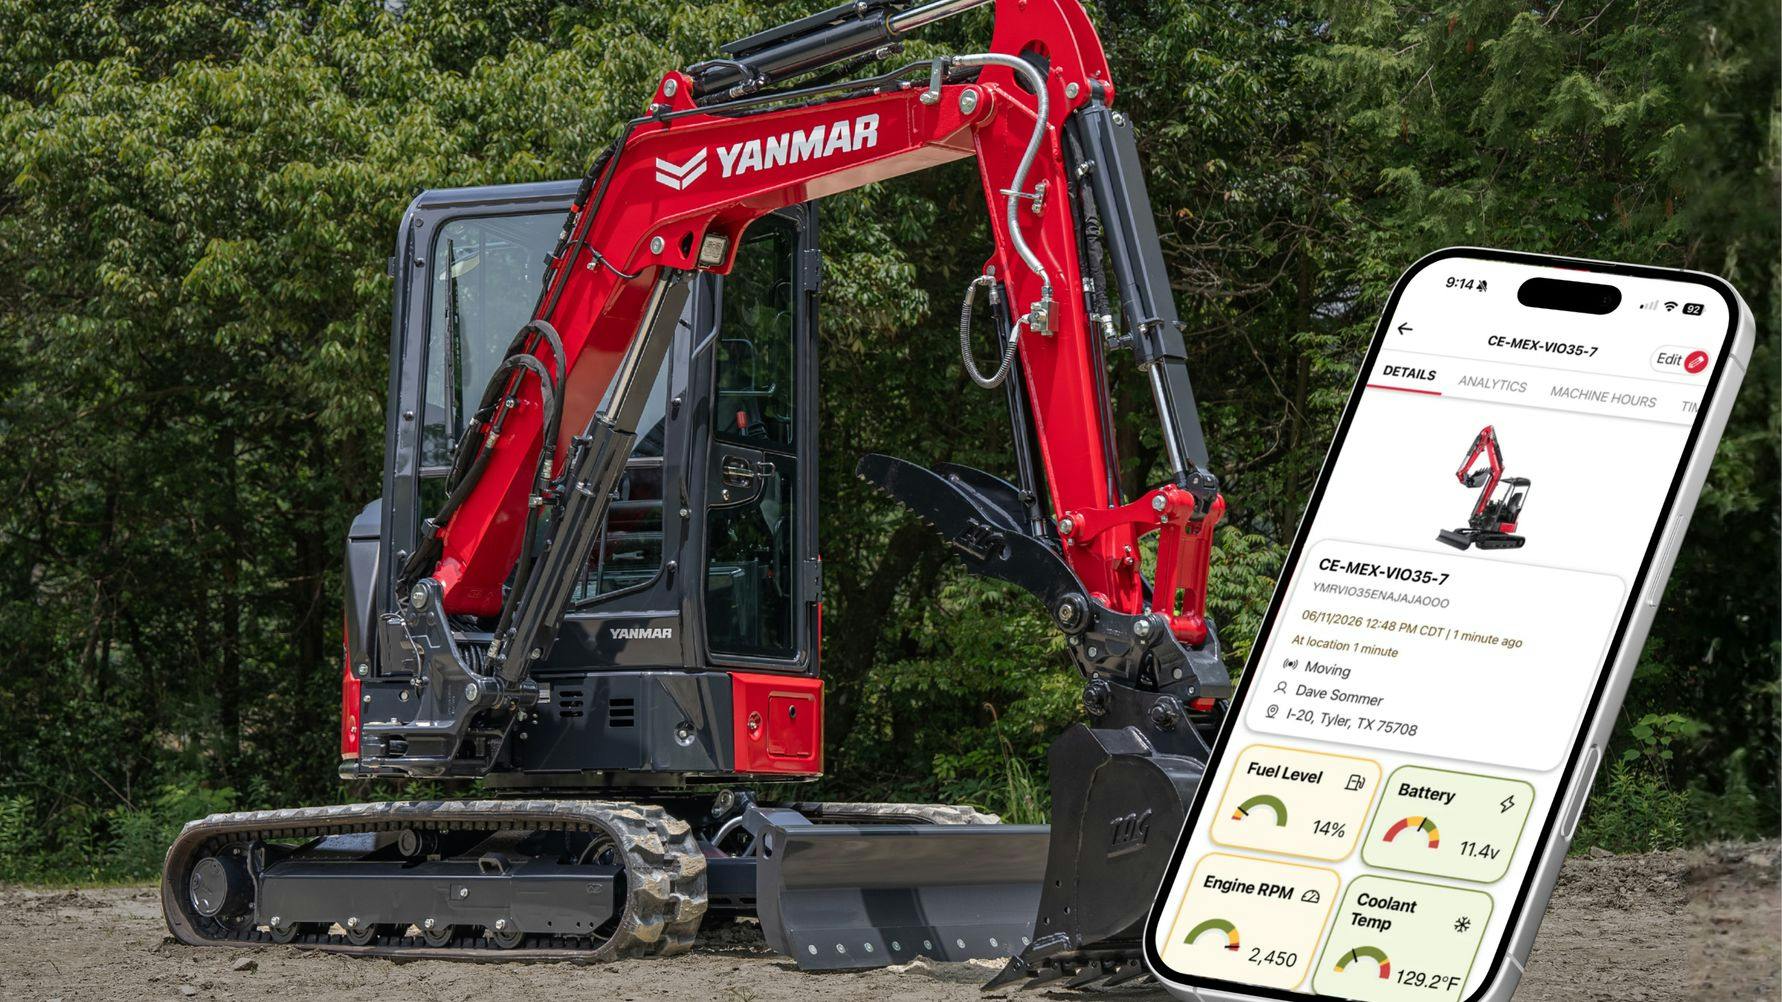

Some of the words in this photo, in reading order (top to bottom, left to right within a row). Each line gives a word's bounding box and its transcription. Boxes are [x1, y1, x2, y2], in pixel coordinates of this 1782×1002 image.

[716, 113, 880, 178] YANMAR
[1446, 277, 1474, 290] 9:14
[1687, 305, 1700, 313] 92
[1657, 353, 1682, 366] Edit
[1383, 365, 1436, 381] DETAILS
[1458, 376, 1527, 392] ANALYTICS
[1551, 386, 1609, 402] MACHINE
[1611, 393, 1657, 408] HOURS
[610, 628, 673, 639] YANMAR
[1302, 610, 1363, 627] 06/11/2026
[1367, 618, 1396, 631] 12:48
[1399, 623, 1417, 633] PM
[1420, 626, 1445, 637] CDT
[1454, 630, 1459, 639] 1
[1461, 632, 1499, 644] minute
[1501, 639, 1522, 649] ago
[1292, 635, 1304, 645] At
[1307, 636, 1350, 651] location
[1354, 643, 1359, 652] 1
[1361, 646, 1398, 657] minute
[1305, 661, 1351, 679] Moving
[1296, 684, 1327, 699] Dave
[1330, 689, 1384, 706] Sommer
[1321, 712, 1351, 729] Tyler,
[1358, 717, 1375, 730] TX
[1377, 720, 1418, 736] 75708
[1247, 762, 1281, 778] Fuel
[1281, 767, 1323, 784] Level
[1398, 783, 1456, 805] Battery
[1314, 820, 1345, 838] 14%
[1461, 841, 1500, 859] 11.4v
[1203, 875, 1255, 894] Engine
[1257, 883, 1294, 900] RPM
[1357, 893, 1417, 913] Coolant
[1352, 912, 1391, 933] Temp
[1248, 947, 1297, 967] 2,450
[1397, 970, 1461, 991] 129.2°F
